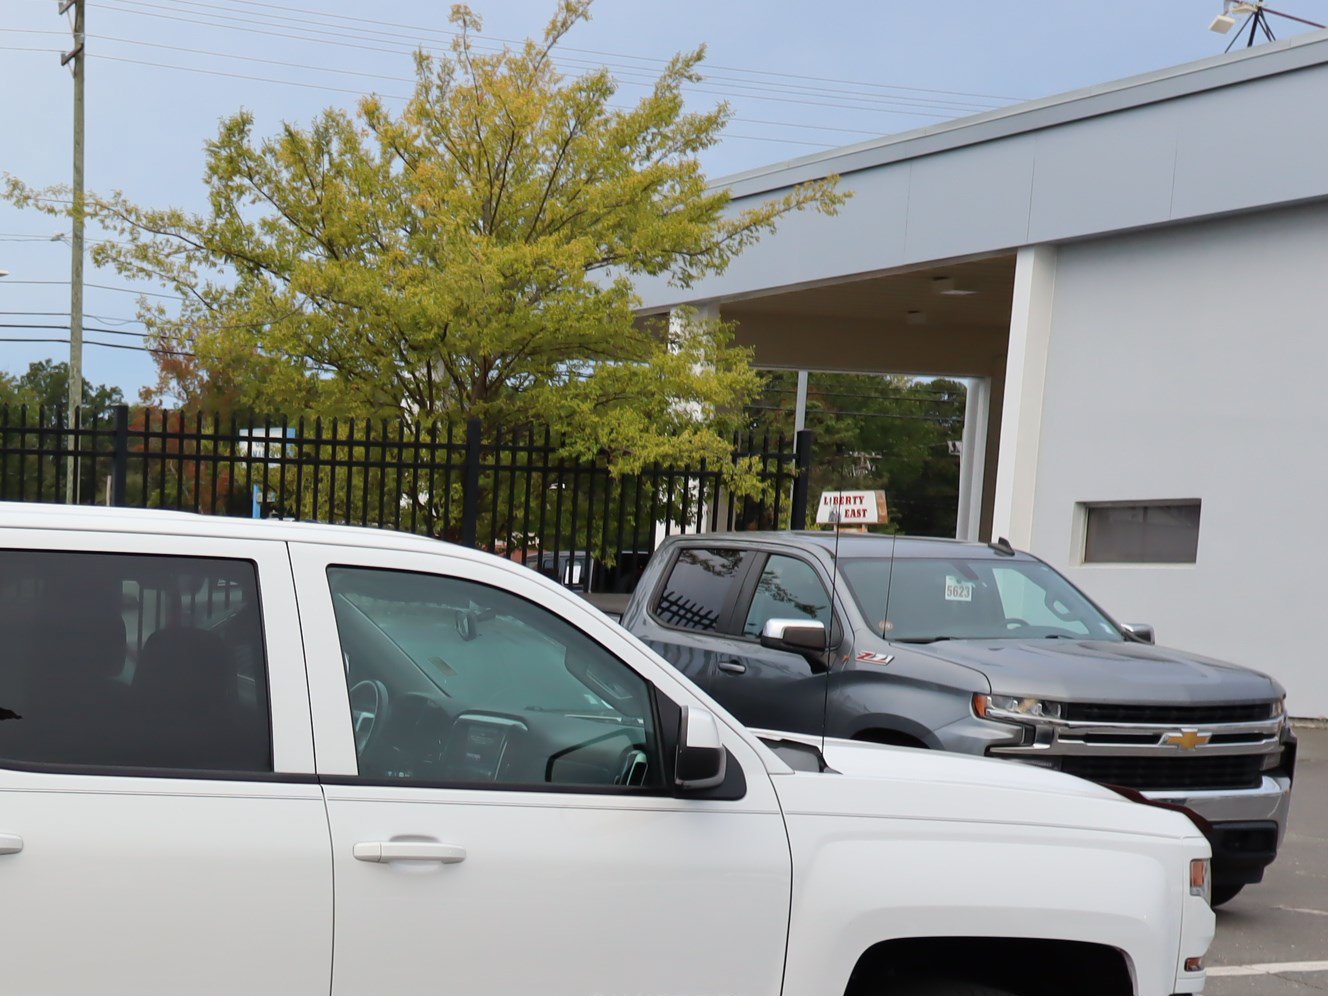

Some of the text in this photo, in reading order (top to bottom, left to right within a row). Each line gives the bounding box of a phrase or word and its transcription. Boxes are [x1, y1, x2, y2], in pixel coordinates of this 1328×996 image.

[823, 496, 865, 506] LIBERTY
[845, 509, 868, 518] EAST
[946, 585, 971, 598] 5623
